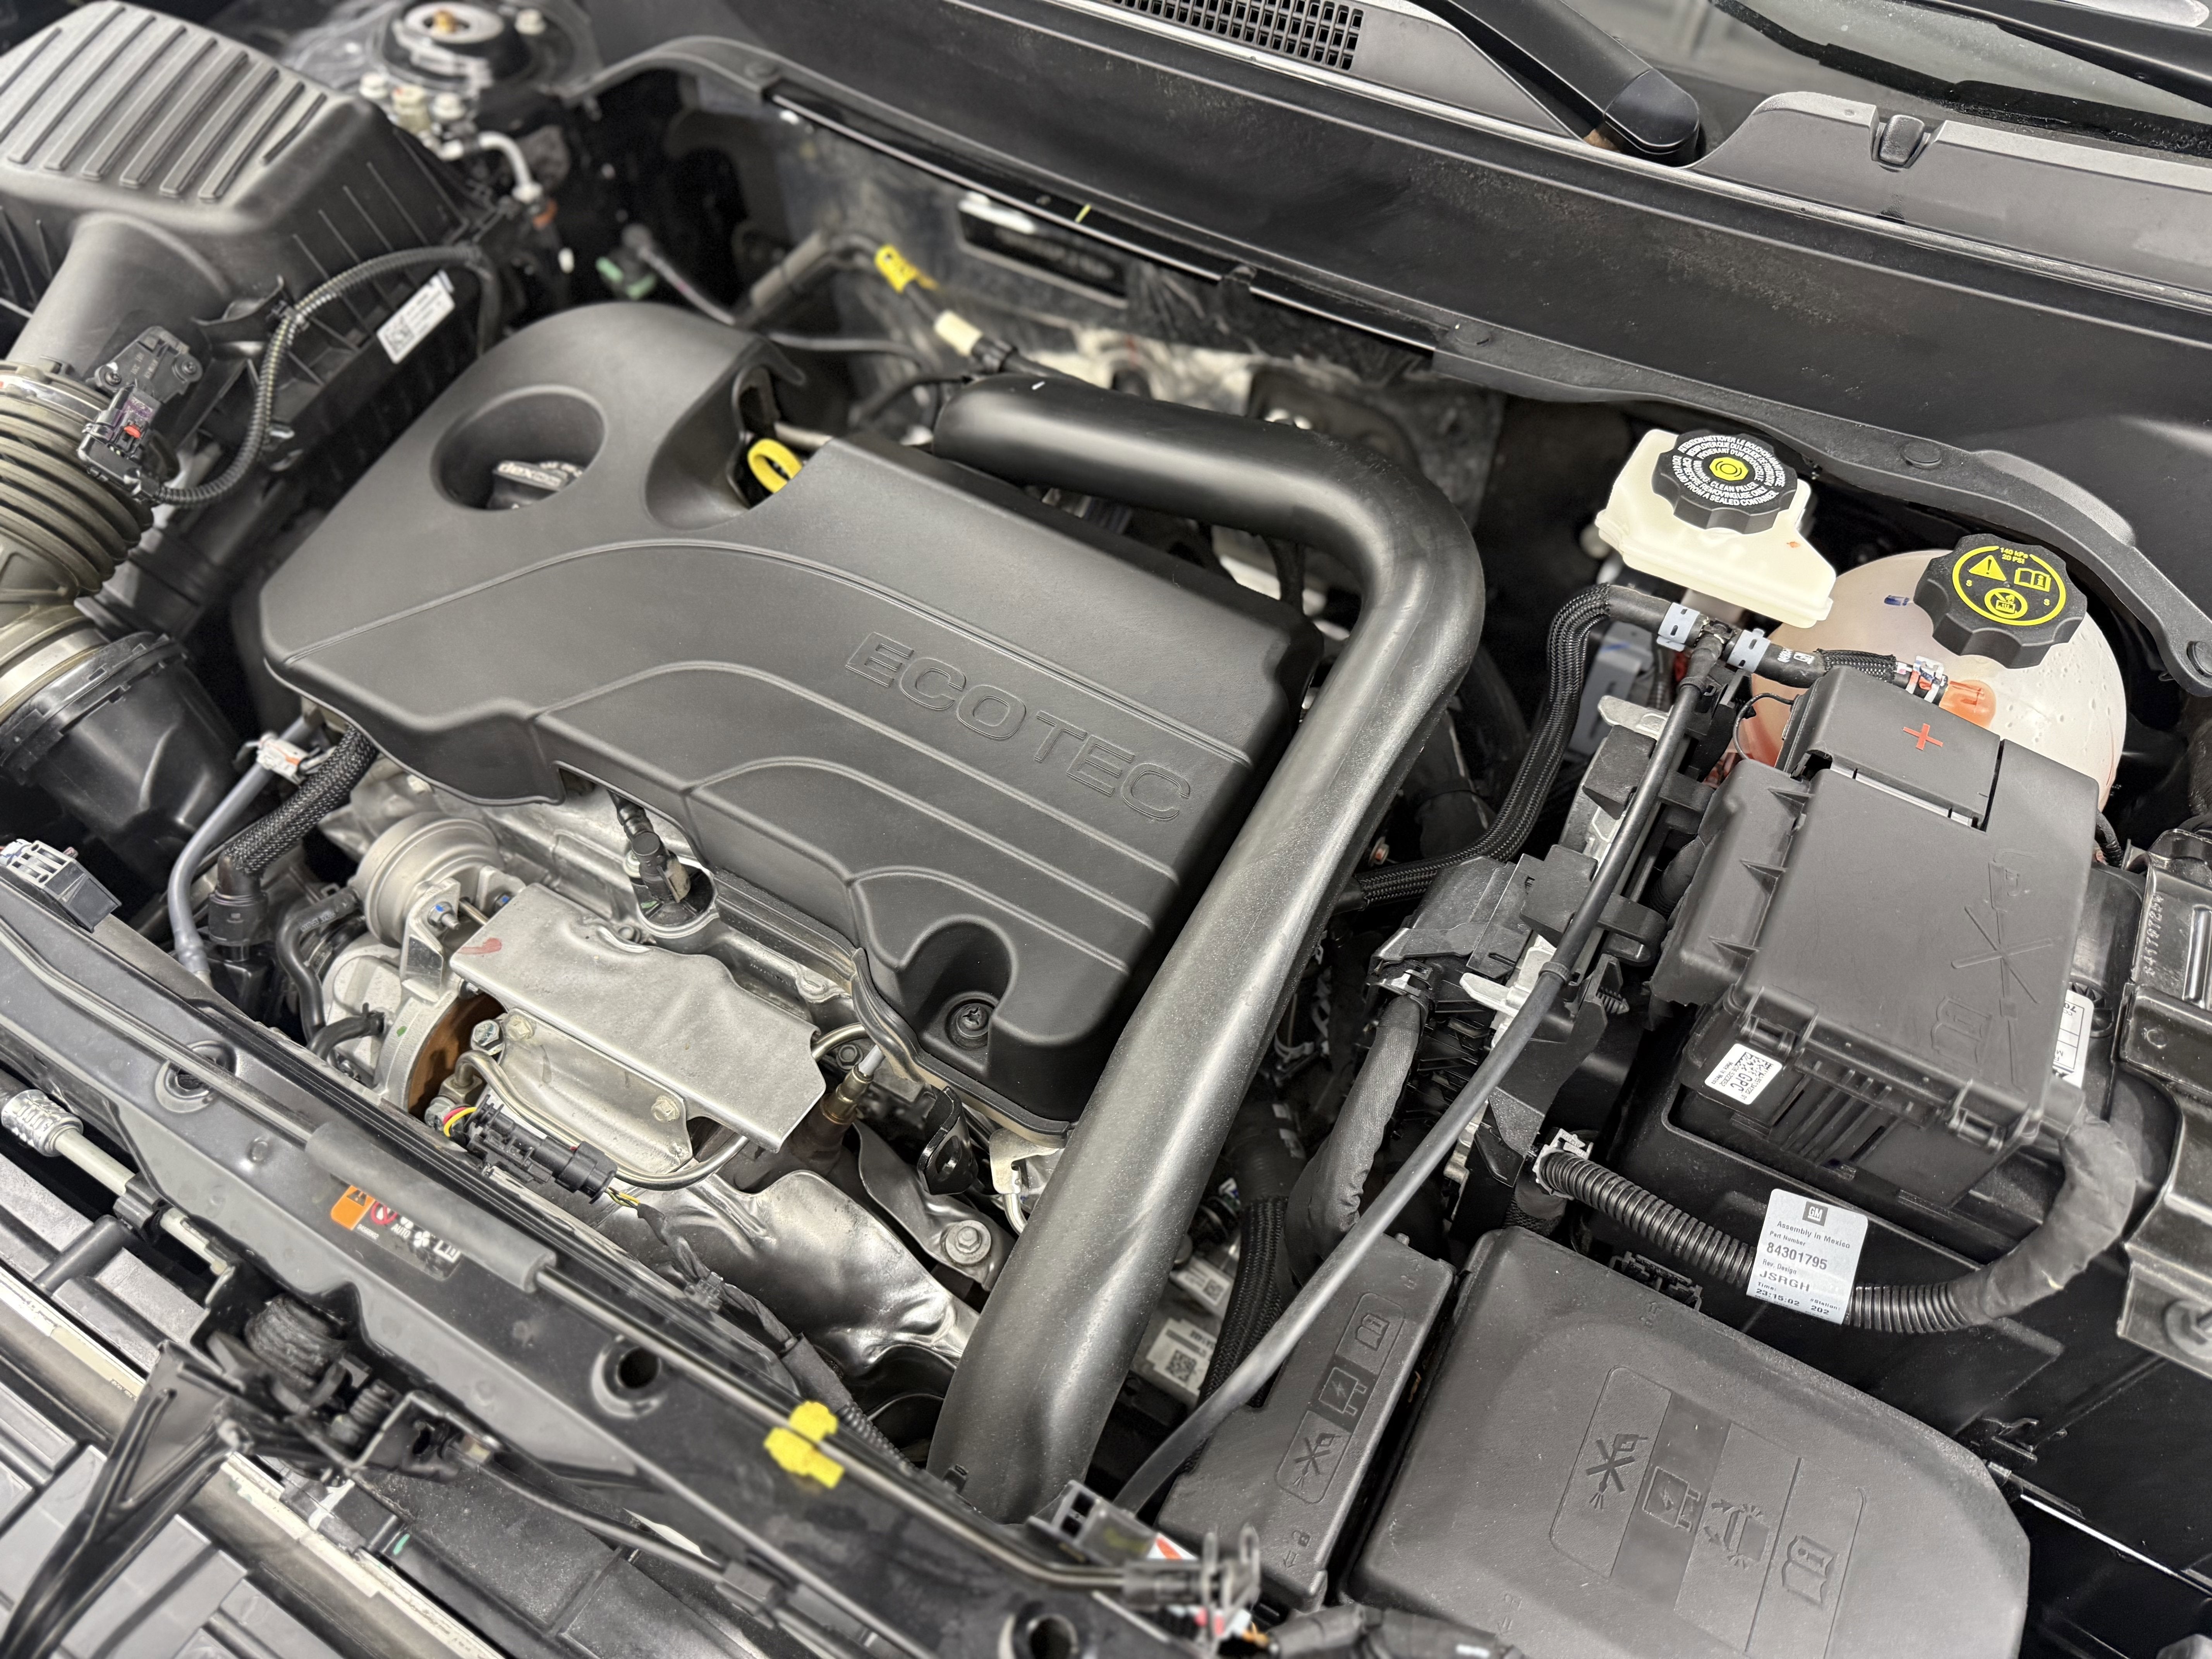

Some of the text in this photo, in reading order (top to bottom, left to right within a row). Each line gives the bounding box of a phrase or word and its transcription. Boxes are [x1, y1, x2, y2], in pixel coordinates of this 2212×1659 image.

[1739, 446, 1762, 459] LIQUIDE
[1745, 441, 1772, 458] BOUCHON
[1767, 457, 1783, 471] AVANT
[1683, 457, 1692, 468] CAP
[1683, 467, 1703, 486] BEFORE
[1693, 460, 1759, 492] WARNING: CLEAN FILLER
[1673, 469, 1689, 483] FLUID
[1684, 482, 1705, 496] FROM
[1709, 495, 1740, 505] SEALED
[1751, 486, 1767, 496] ONLY
[2014, 551, 2028, 559] kPa
[845, 632, 1190, 821] ECOTEC
[1730, 1073, 1753, 1091] GPC
[1808, 1206, 1823, 1219] GM
[391, 1223, 411, 1240] AUTO
[1777, 1221, 1812, 1237] Assembly
[1824, 1235, 1850, 1249] Mexico
[1783, 1235, 1805, 1246] Number
[1767, 1242, 1827, 1270] 84301795
[1778, 1264, 1796, 1274] Design
[1758, 1282, 1776, 1291] Time:
[1760, 1271, 1810, 1291] JSRGH
[1756, 1288, 1800, 1306] 23:15:02
[1811, 1305, 1829, 1315] 202
